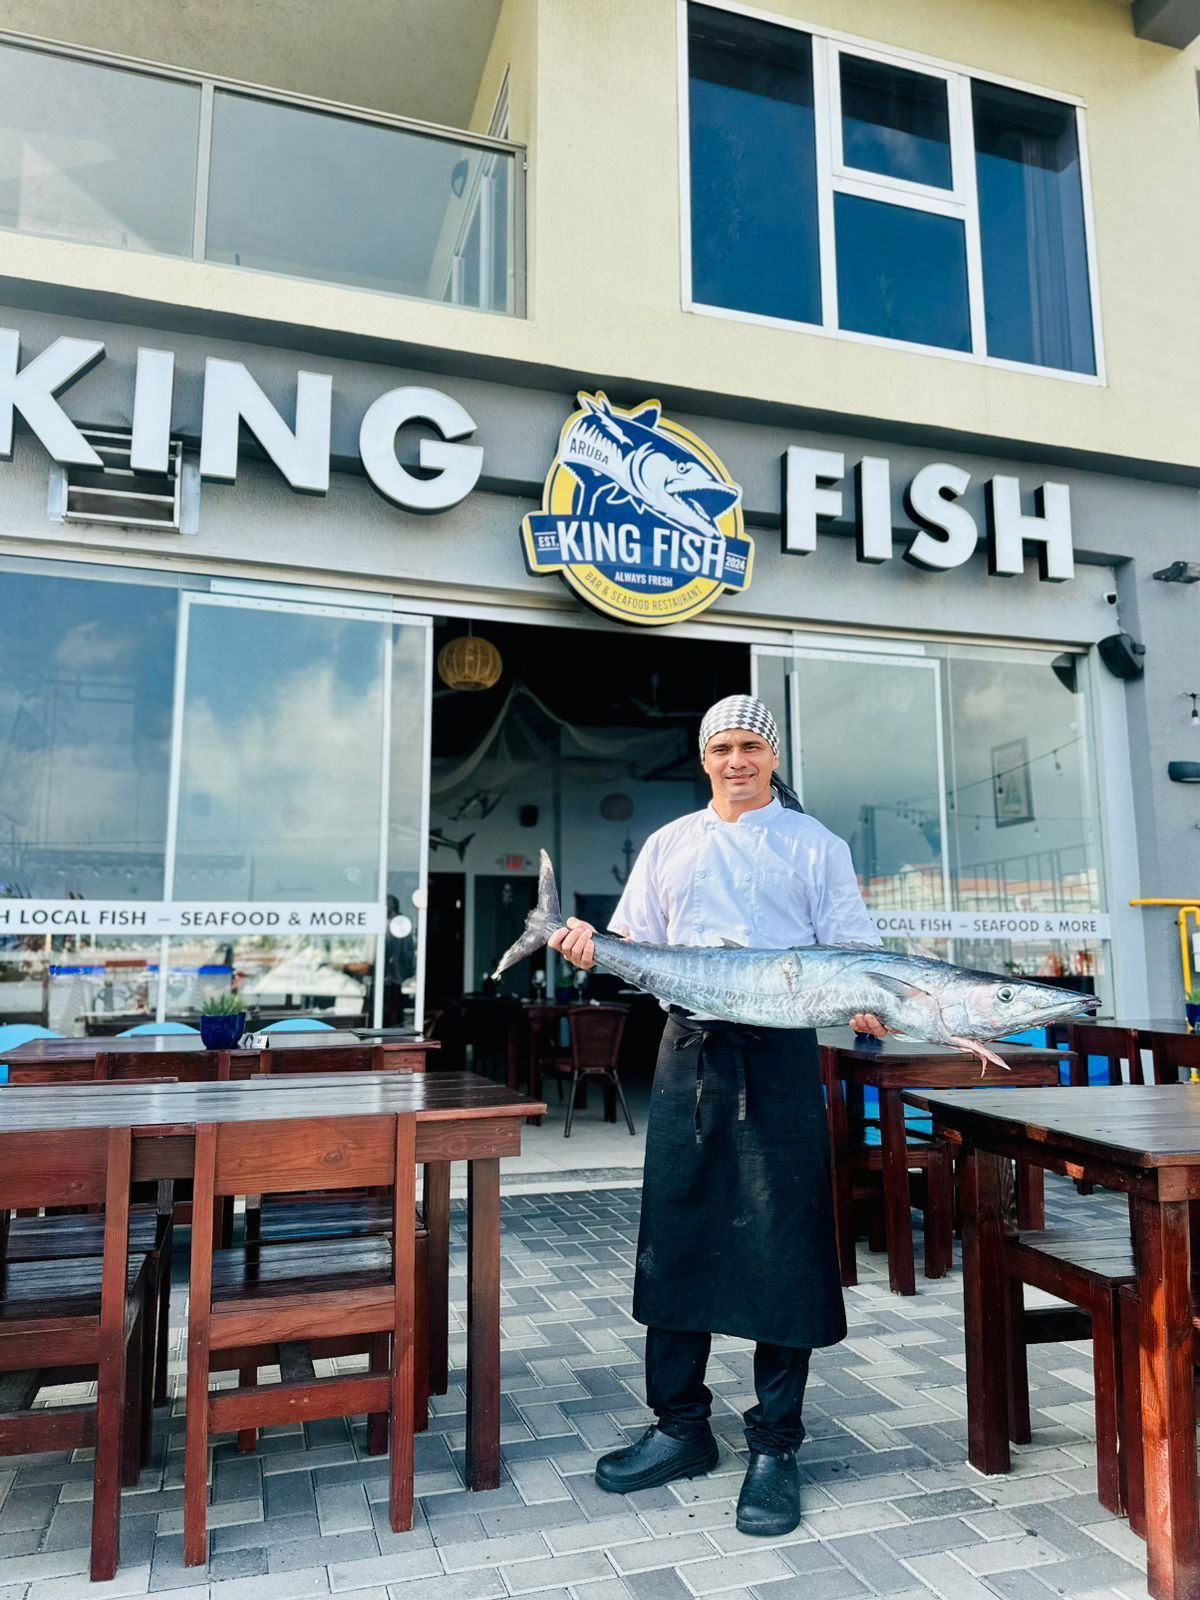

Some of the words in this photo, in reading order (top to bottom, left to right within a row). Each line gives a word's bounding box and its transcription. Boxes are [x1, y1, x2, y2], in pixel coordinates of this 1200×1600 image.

[0, 329, 484, 510] KING
[785, 445, 1075, 581] FISH
[569, 438, 609, 466] ARUBA
[538, 535, 560, 548] EST.
[556, 520, 641, 565] KING
[653, 527, 727, 578] FISH
[725, 556, 746, 571] 2024
[614, 571, 647, 585] ALWAYS
[648, 574, 673, 587] FRESH
[584, 571, 601, 590] BAR
[601, 586, 609, 596] &
[611, 590, 649, 610] SEAFOOD
[652, 585, 703, 610] RESTAURANT
[20, 909, 91, 925] LOCAL
[99, 910, 147, 925] FISH
[180, 911, 280, 926] SEAFOOD
[287, 912, 302, 926] &
[309, 911, 367, 926] MORE
[870, 917, 916, 931] OCAL
[920, 918, 952, 931] FISH
[973, 919, 1040, 932] SEAFOOD
[1044, 920, 1054, 932] &
[1059, 920, 1097, 932] MORE
